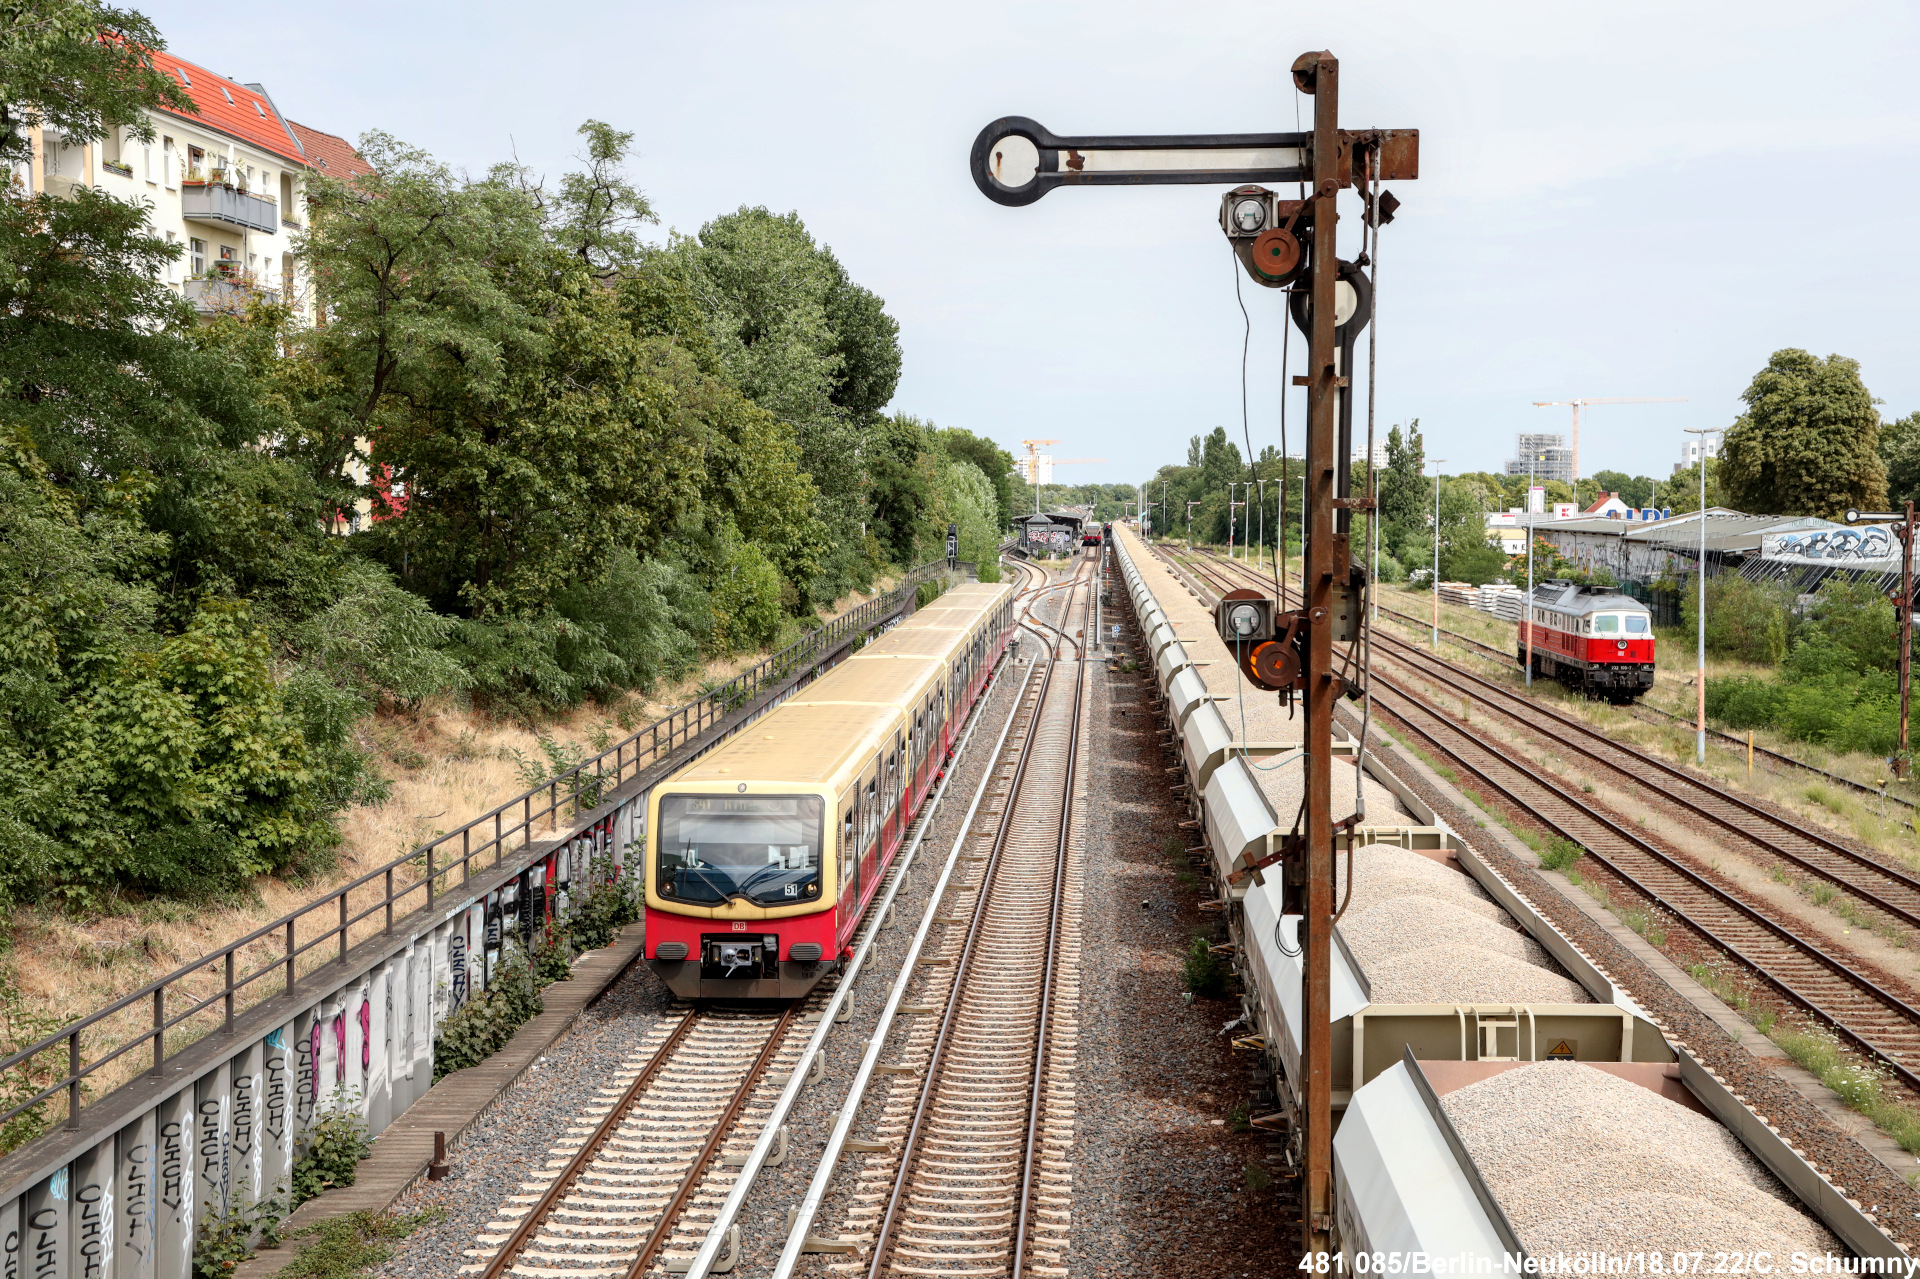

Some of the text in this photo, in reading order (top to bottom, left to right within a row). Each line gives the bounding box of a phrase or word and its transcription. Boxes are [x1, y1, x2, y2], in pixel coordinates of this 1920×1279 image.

[693, 798, 711, 809] S41
[733, 922, 746, 930] DB
[786, 885, 797, 894] 51
[233, 1076, 252, 1163] CLICHY
[266, 1057, 285, 1145] CLICHY
[295, 1040, 313, 1125] CLICHY
[160, 1122, 182, 1222] CLICHY
